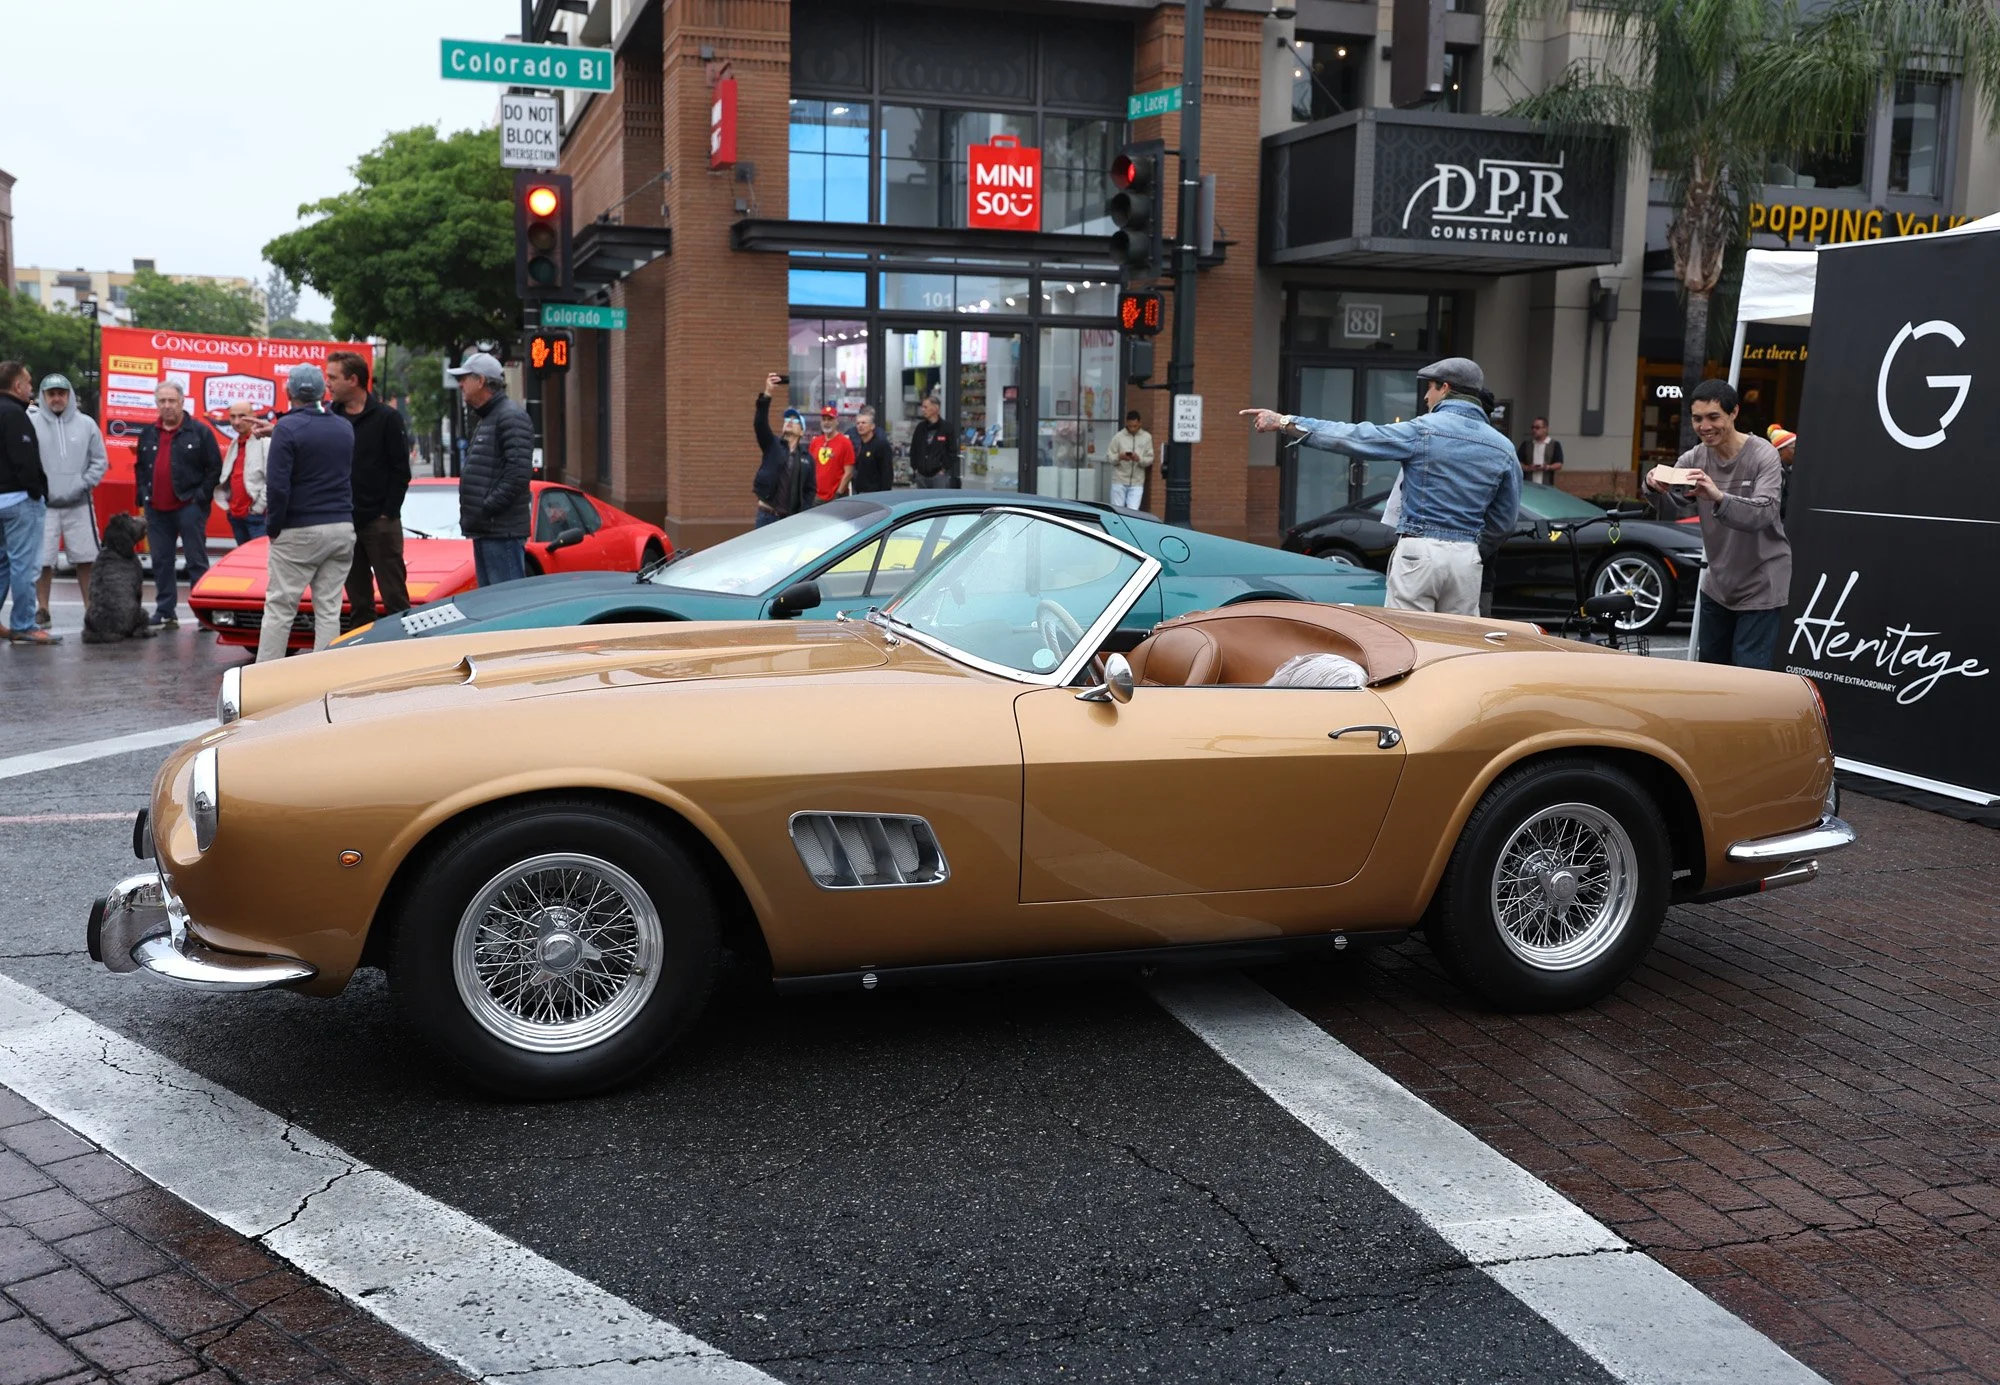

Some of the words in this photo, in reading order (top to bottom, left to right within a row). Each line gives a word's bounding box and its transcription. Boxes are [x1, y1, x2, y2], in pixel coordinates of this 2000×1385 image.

[451, 48, 567, 78] Colorado
[579, 58, 603, 81] Bl
[504, 104, 522, 121] DO
[528, 106, 554, 122] NOT
[1143, 94, 1169, 113] Lacey
[507, 128, 552, 145] BLOCK
[505, 148, 556, 161] INTERSECTION
[976, 163, 1033, 188] MINI
[1432, 163, 1569, 219] DPR
[1431, 225, 1568, 245] CONSTRUCTION
[923, 292, 952, 307] 101
[545, 306, 600, 325] Colorado
[1350, 309, 1376, 332] 88
[1743, 344, 1764, 359] Let
[1766, 344, 1795, 360] there
[1799, 345, 1808, 361] b
[209, 381, 272, 391] CONCORSO
[1877, 320, 1972, 449] G
[209, 390, 272, 400] FERRARI
[1788, 570, 1990, 704] Heritage
[1785, 665, 1824, 679] CUSTODIANS
[1824, 672, 1833, 680] OF
[1833, 673, 1844, 683] THE
[1844, 676, 1897, 692] EXTRAORDINARY
